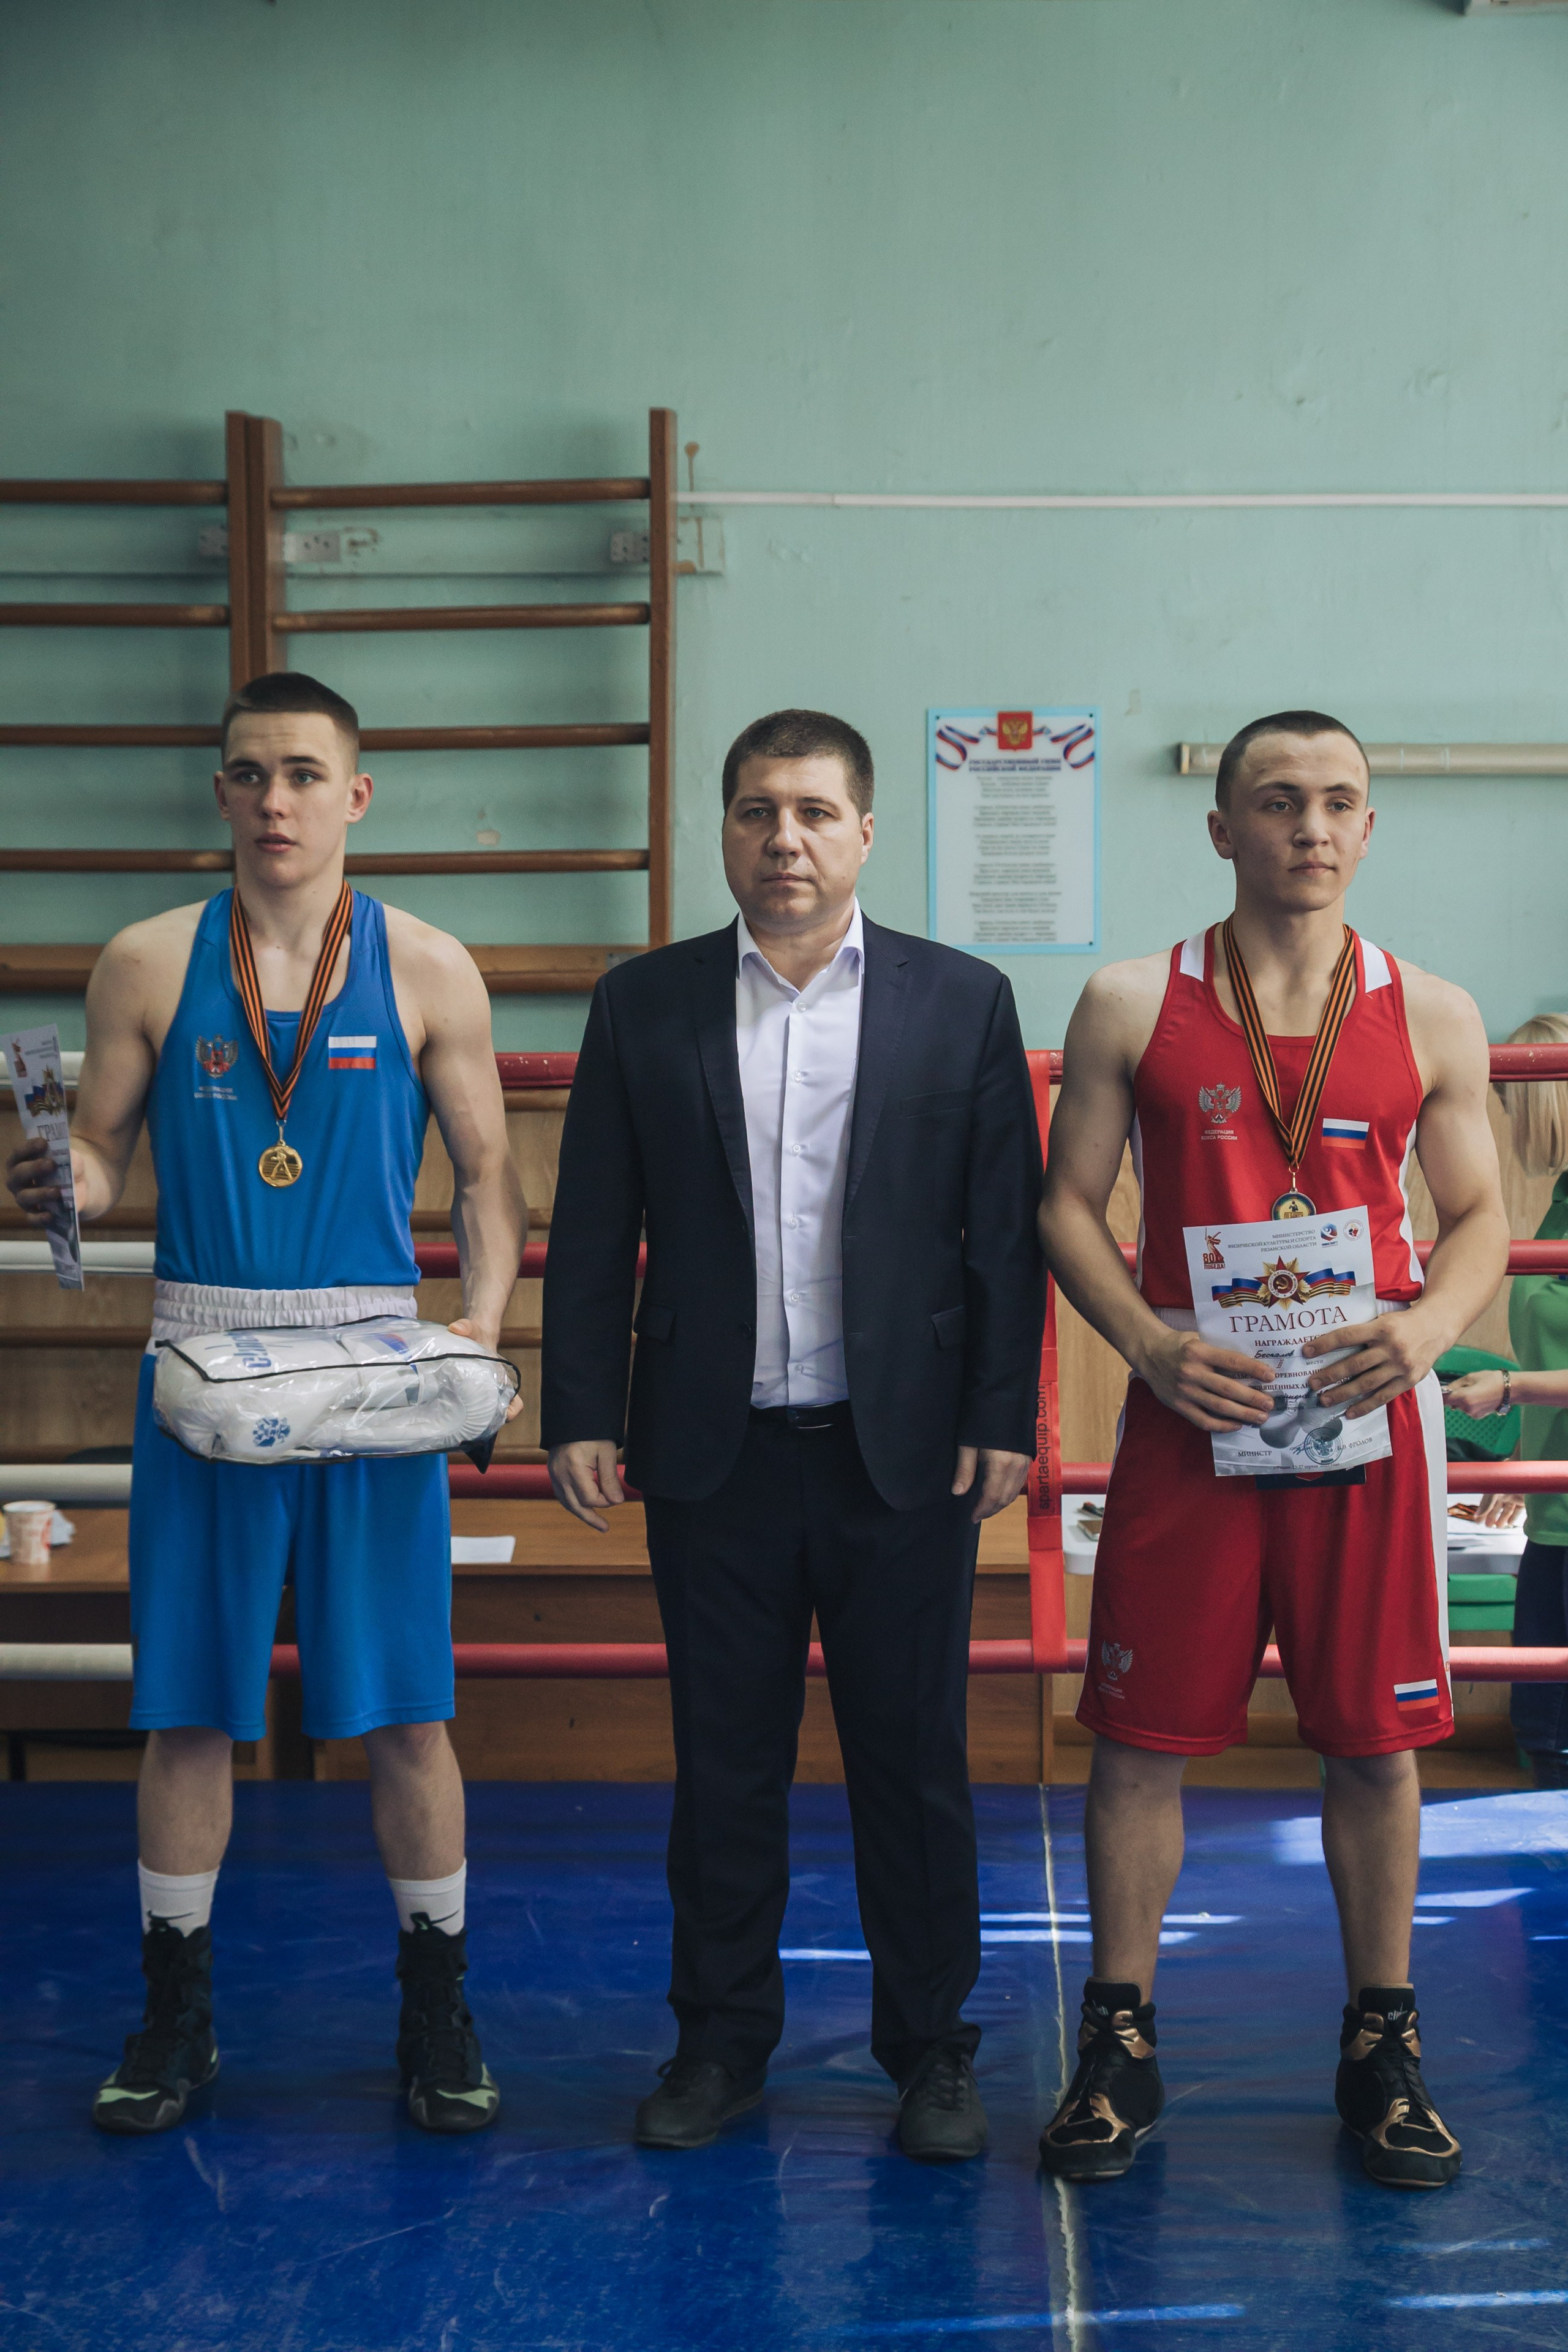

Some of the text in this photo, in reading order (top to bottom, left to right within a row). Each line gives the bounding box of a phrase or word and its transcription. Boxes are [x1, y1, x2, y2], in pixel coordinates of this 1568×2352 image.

[1272, 1229, 1316, 1239] МИНИСТЕРСТВО
[1229, 1306, 1348, 1332] ГРАМОТА
[1037, 1385, 1050, 1509] spartaequip.com
